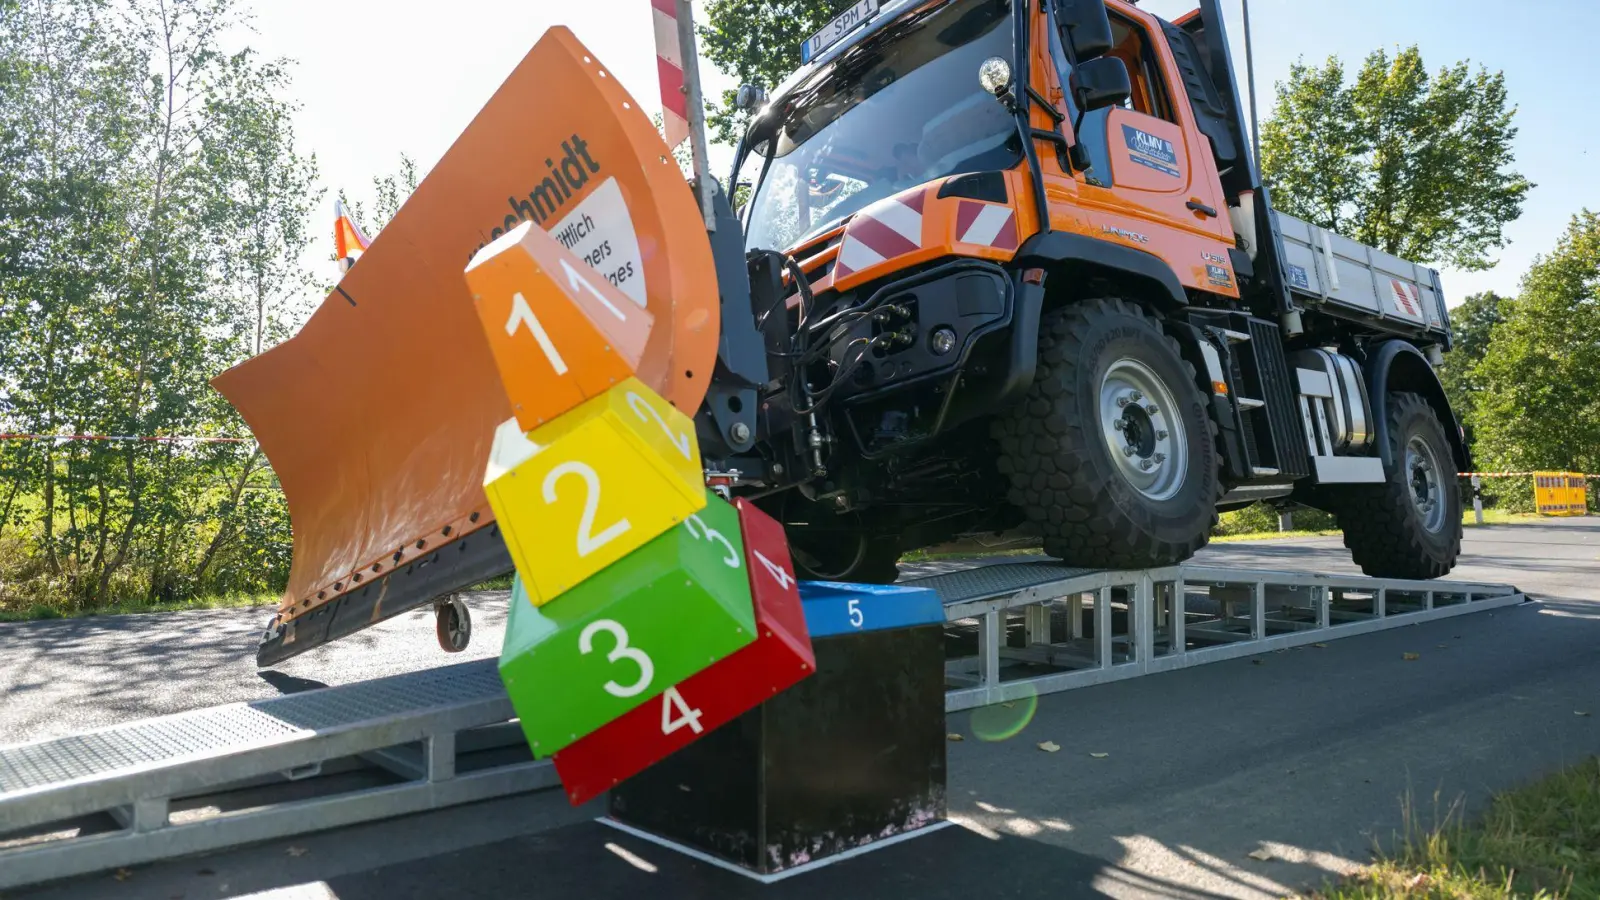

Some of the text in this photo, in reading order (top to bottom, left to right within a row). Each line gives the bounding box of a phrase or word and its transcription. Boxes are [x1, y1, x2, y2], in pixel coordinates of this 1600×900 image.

[812, 34, 821, 52] D
[834, 6, 860, 36] SPM
[863, 0, 873, 15] 1
[1135, 130, 1163, 151] KLMV
[583, 239, 612, 269] ners
[559, 257, 627, 322] 1
[504, 291, 569, 377] 1
[625, 390, 692, 462] 2
[541, 460, 632, 558] 2
[683, 512, 741, 569] 3
[752, 548, 796, 591] 4
[847, 598, 864, 628] 5
[577, 617, 655, 698] 3
[660, 685, 704, 736] 4
